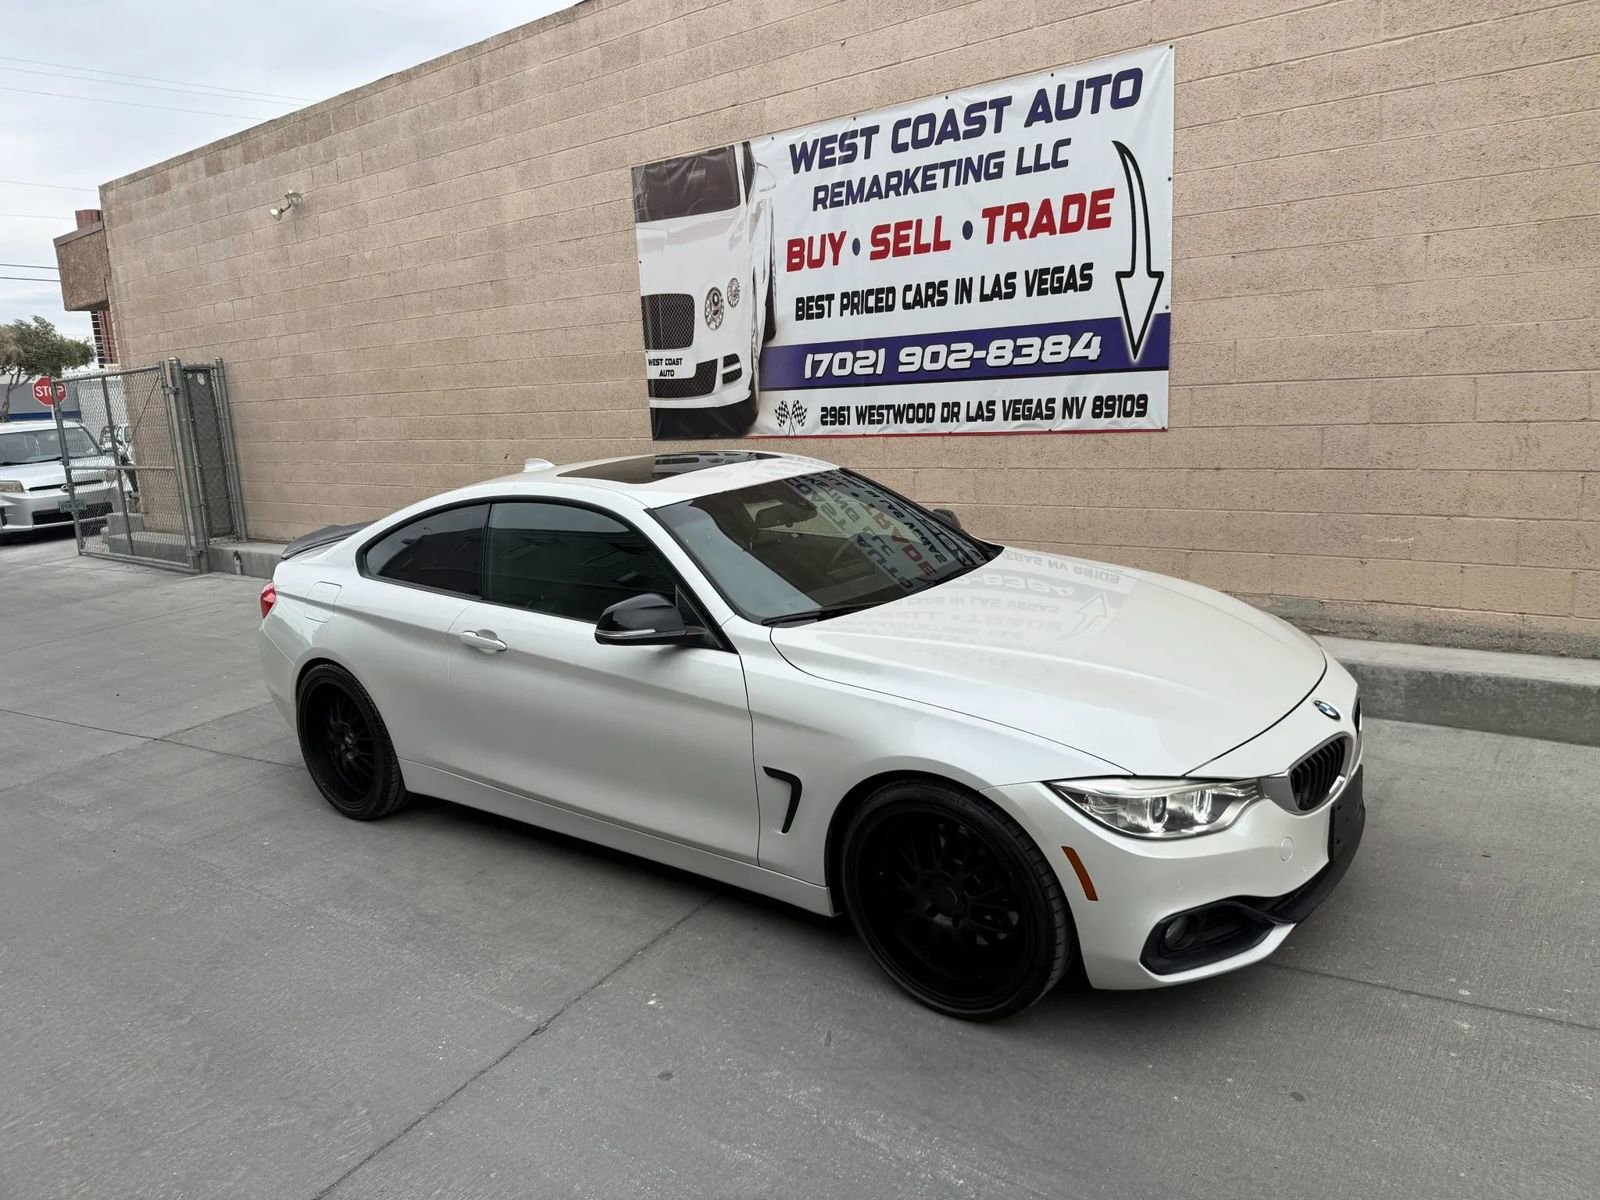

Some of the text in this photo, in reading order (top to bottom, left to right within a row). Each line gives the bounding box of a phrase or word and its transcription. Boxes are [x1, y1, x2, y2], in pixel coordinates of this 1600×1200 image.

[789, 67, 1144, 175] WEST COAST AUTO
[812, 138, 1072, 212] REMARKETING LLC
[786, 187, 1116, 273] BUY SELL TRADE
[795, 262, 1094, 322] BEST PRICED CARS IN LAS VEGAS
[648, 358, 683, 366] WEST COAST
[659, 369, 674, 377] AUTO
[804, 332, 1102, 380] (702) 902-8384
[820, 393, 1149, 426] 2961 WESTWOOD DR LAS VEGAS NV 89109
